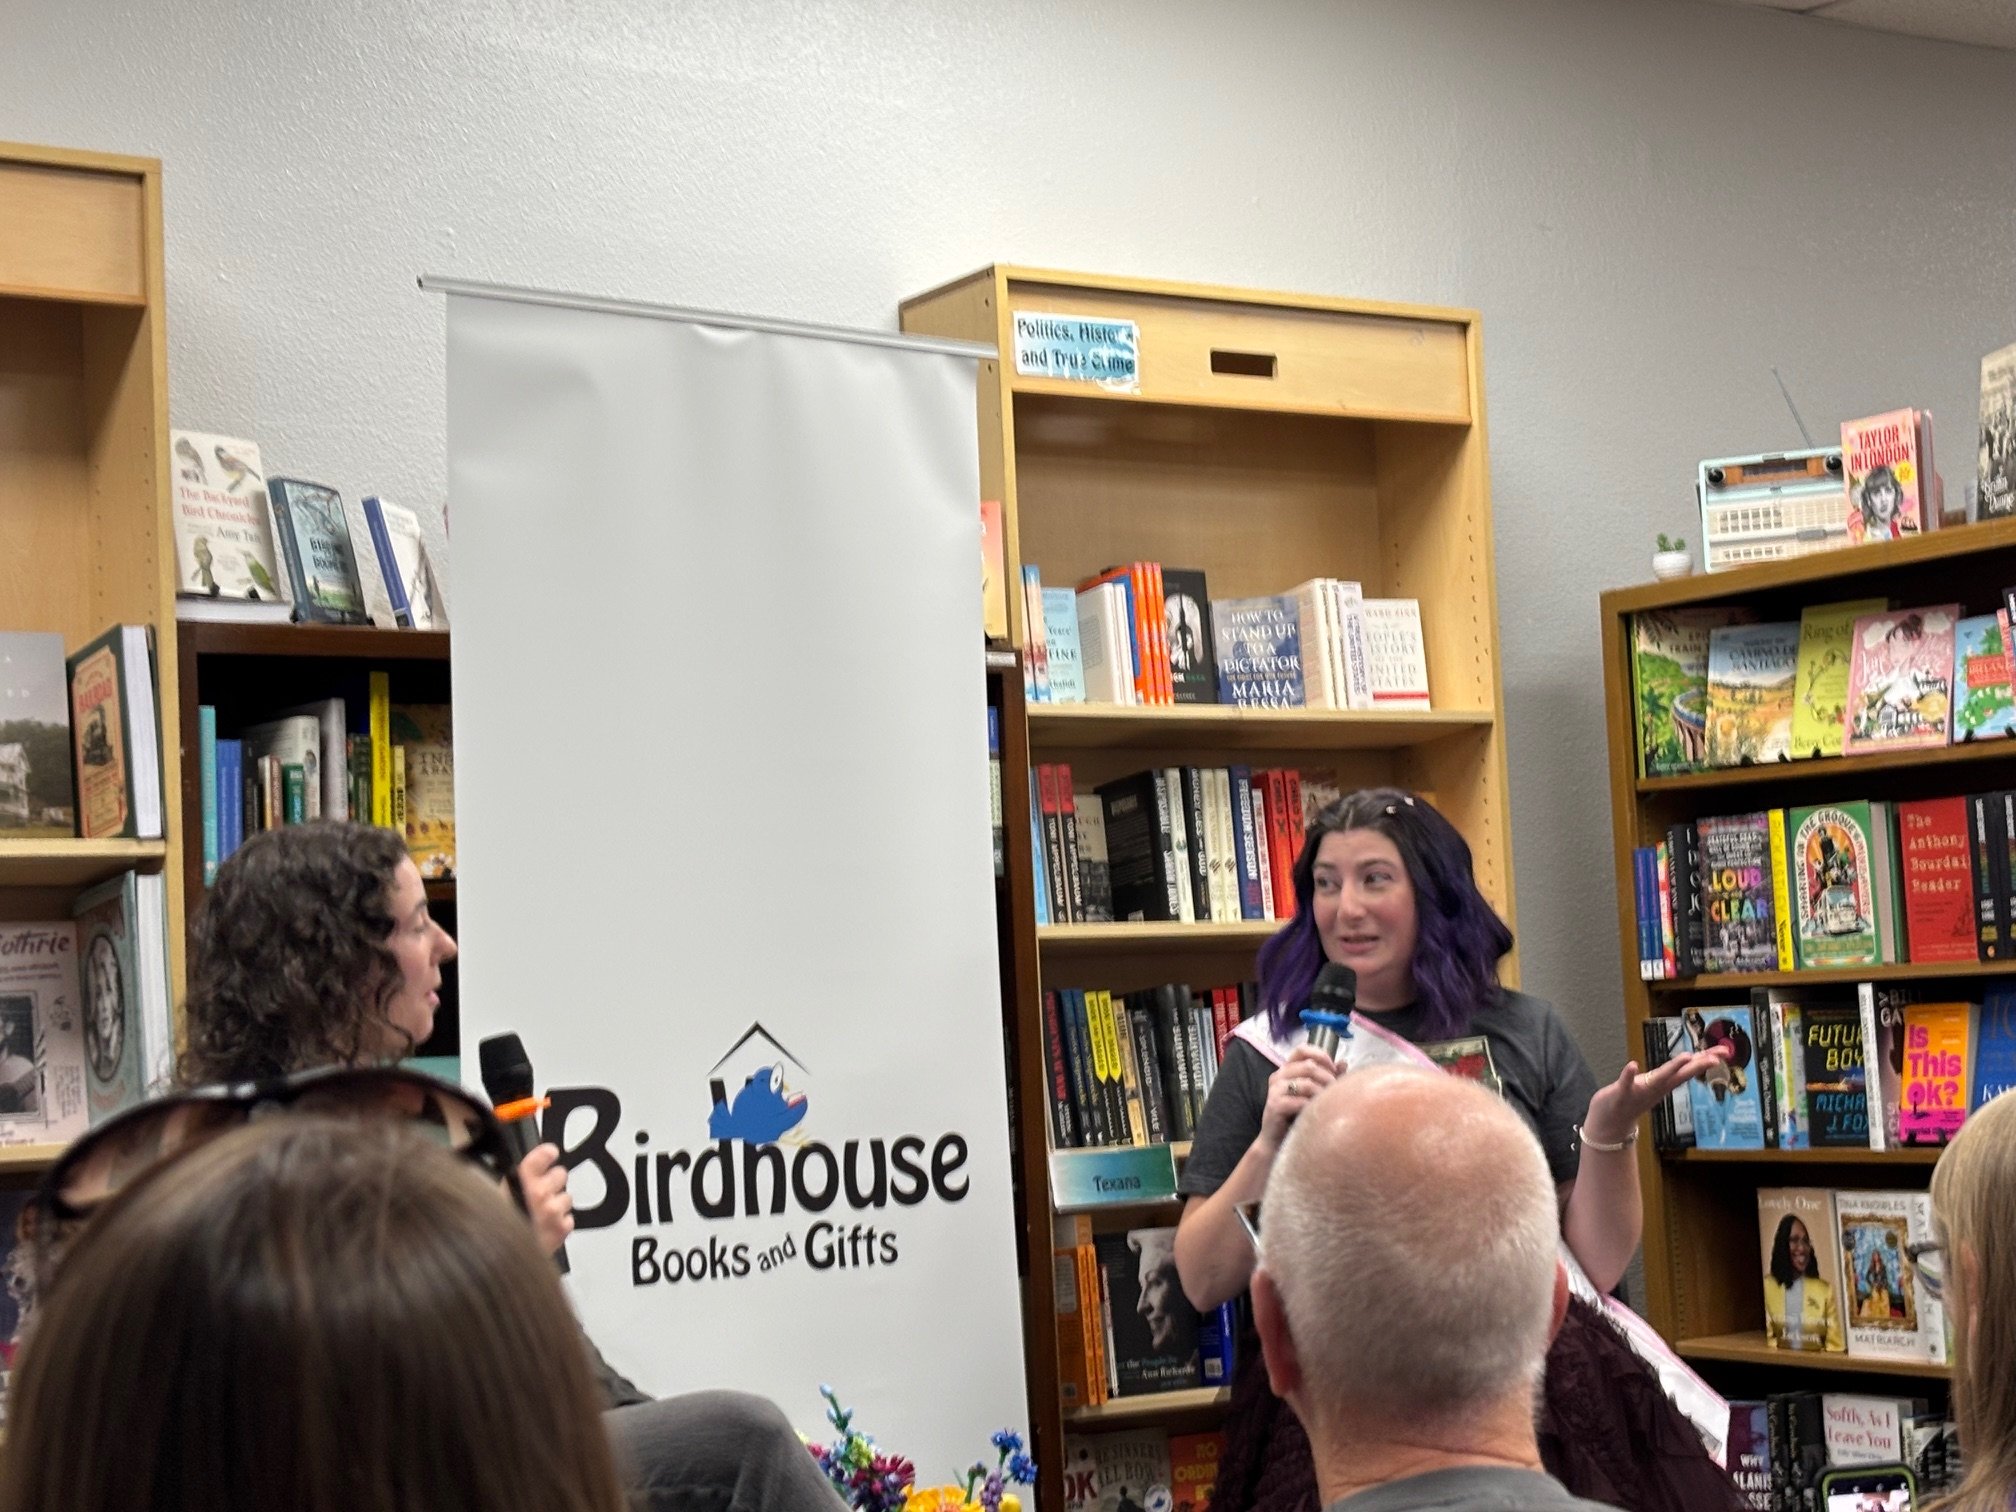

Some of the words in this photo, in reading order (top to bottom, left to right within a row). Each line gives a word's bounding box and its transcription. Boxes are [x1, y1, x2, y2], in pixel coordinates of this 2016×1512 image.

[1018, 318, 1075, 342] Politics,
[1022, 347, 1048, 367] and
[1858, 425, 1899, 450] TAYLOR
[1851, 454, 1864, 471] IN
[1864, 442, 1910, 468] LONDON
[179, 487, 200, 499] The
[204, 490, 250, 508] Backyard
[182, 504, 205, 518] Bird
[208, 507, 262, 526] Chronicles
[216, 526, 240, 541] Amy
[1231, 610, 1260, 624] HOW
[1264, 608, 1284, 622] TO
[1222, 625, 1272, 642] STAND
[1275, 623, 1296, 640] UP
[1804, 624, 1836, 644] Ring
[1243, 642, 1264, 656] TO
[1266, 642, 1278, 656] A
[1224, 656, 1301, 674] DICTATOR
[1232, 679, 1295, 698] MARIA
[1818, 810, 1858, 837] GROOVE
[1906, 814, 1932, 828] The
[1908, 834, 1966, 850] Anthony
[1910, 854, 1971, 872] Bourdai
[1712, 867, 1762, 892] LOUD
[1912, 878, 1962, 893] Reader
[1710, 896, 1770, 924] CLEAR
[0, 930, 70, 956] uthrie
[1808, 1024, 1863, 1048] FUTUR
[1908, 1024, 1929, 1048] Is
[1826, 1048, 1864, 1072] BOY
[1908, 1050, 1962, 1078] This
[1816, 1094, 1866, 1112] MICHA
[1906, 1080, 1960, 1106] Ok?
[541, 1077, 970, 1273] Birdhouse
[1092, 1174, 1142, 1192] Texana
[1794, 1196, 1822, 1210] One
[1860, 1200, 1906, 1210] KNOWLES
[632, 1236, 750, 1286] Books
[758, 1233, 797, 1272] and
[804, 1220, 900, 1270] Gifts
[1856, 1334, 1916, 1347] MATRIARCH
[1827, 1405, 1865, 1427] Softly,
[1828, 1424, 1863, 1446] Leave
[1866, 1430, 1890, 1449] You
[1197, 1443, 1217, 1458] NO
[1740, 1454, 1764, 1468] WHY
[1174, 1462, 1219, 1482] ORDIN
